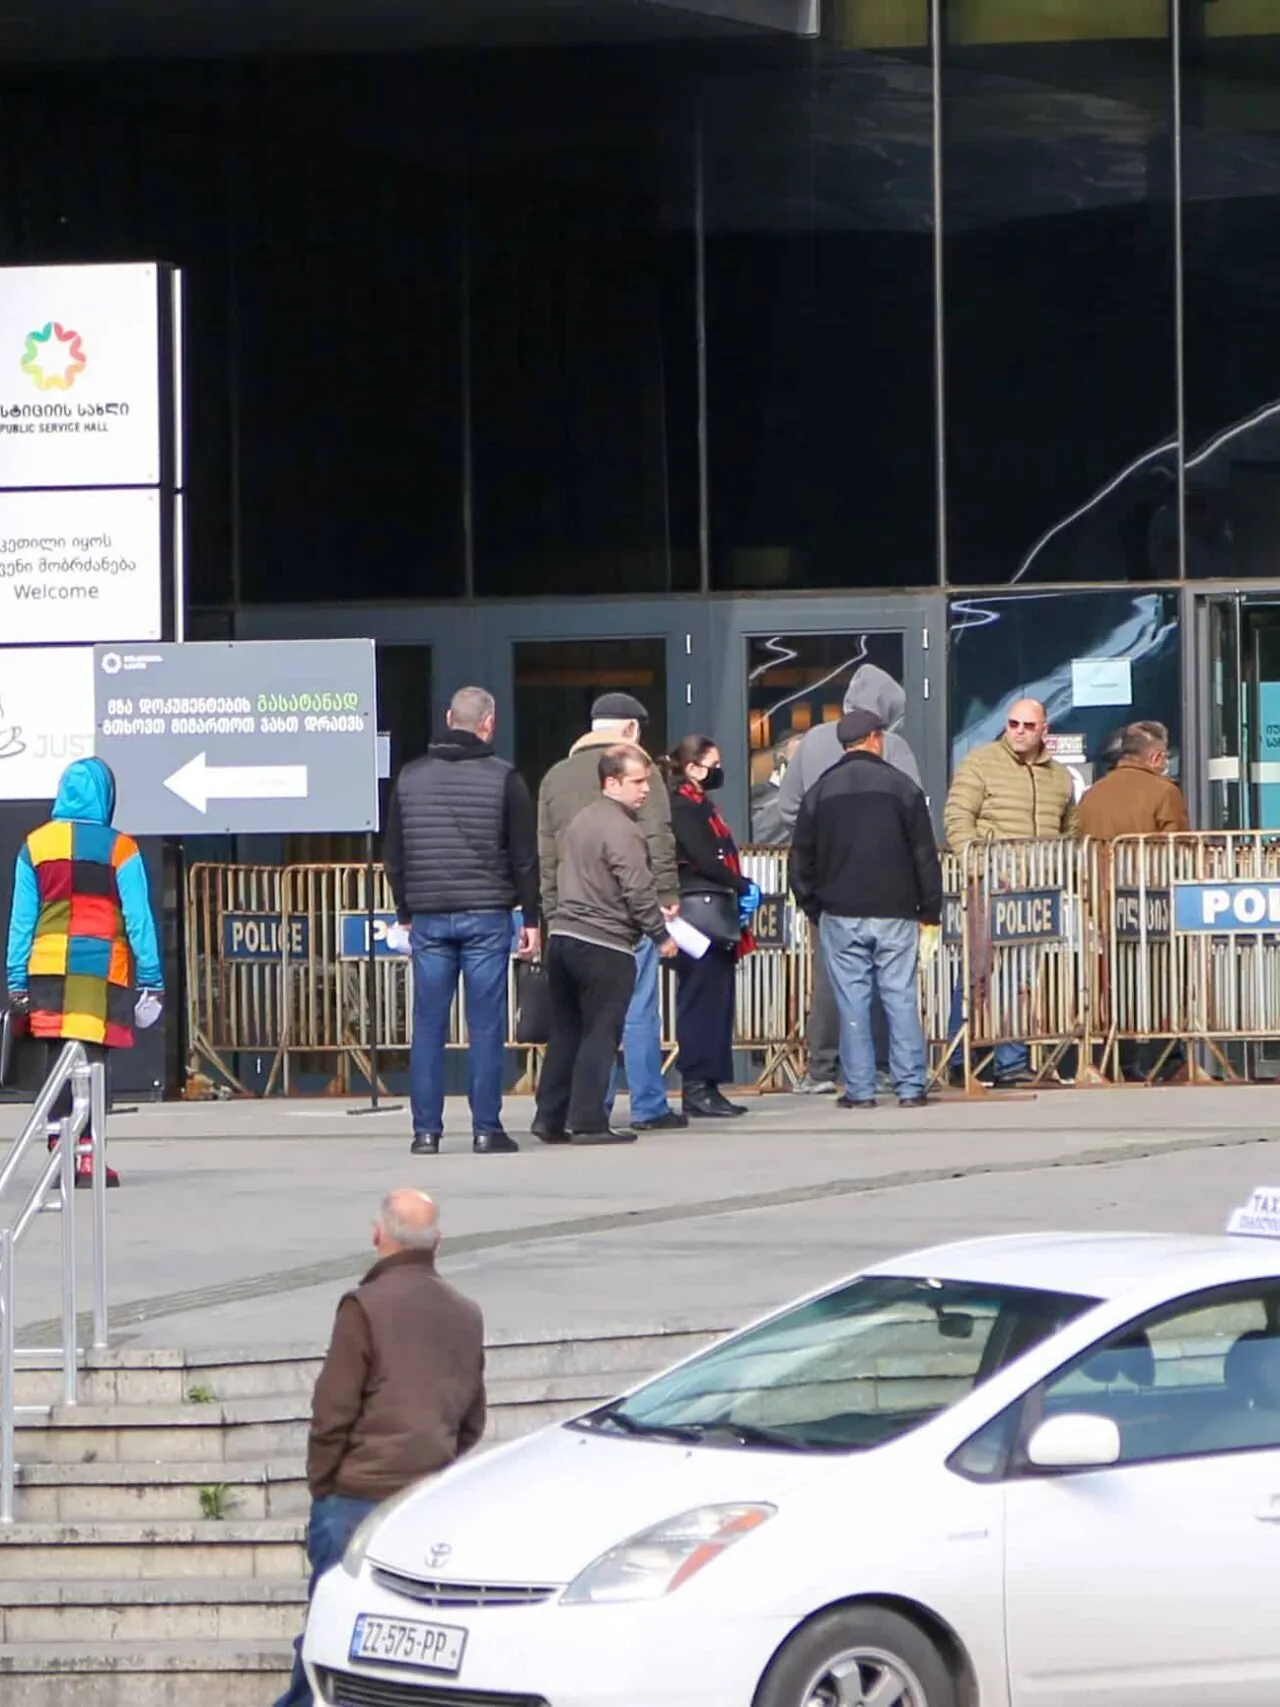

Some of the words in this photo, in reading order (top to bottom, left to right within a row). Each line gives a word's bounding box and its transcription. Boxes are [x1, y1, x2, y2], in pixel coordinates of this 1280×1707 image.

[77, 401, 130, 417] სახლი
[0, 422, 35, 434] PUBLIC
[38, 421, 81, 433] SERVICE
[84, 420, 109, 432] HALL
[0, 536, 66, 554] კეთილი
[72, 532, 112, 551] იყოს
[38, 554, 137, 576] მობრძანება
[13, 583, 100, 600] Welcome
[257, 691, 359, 713] გასატანად
[995, 898, 1052, 935] POLICE
[1254, 1195, 1280, 1212] TAX
